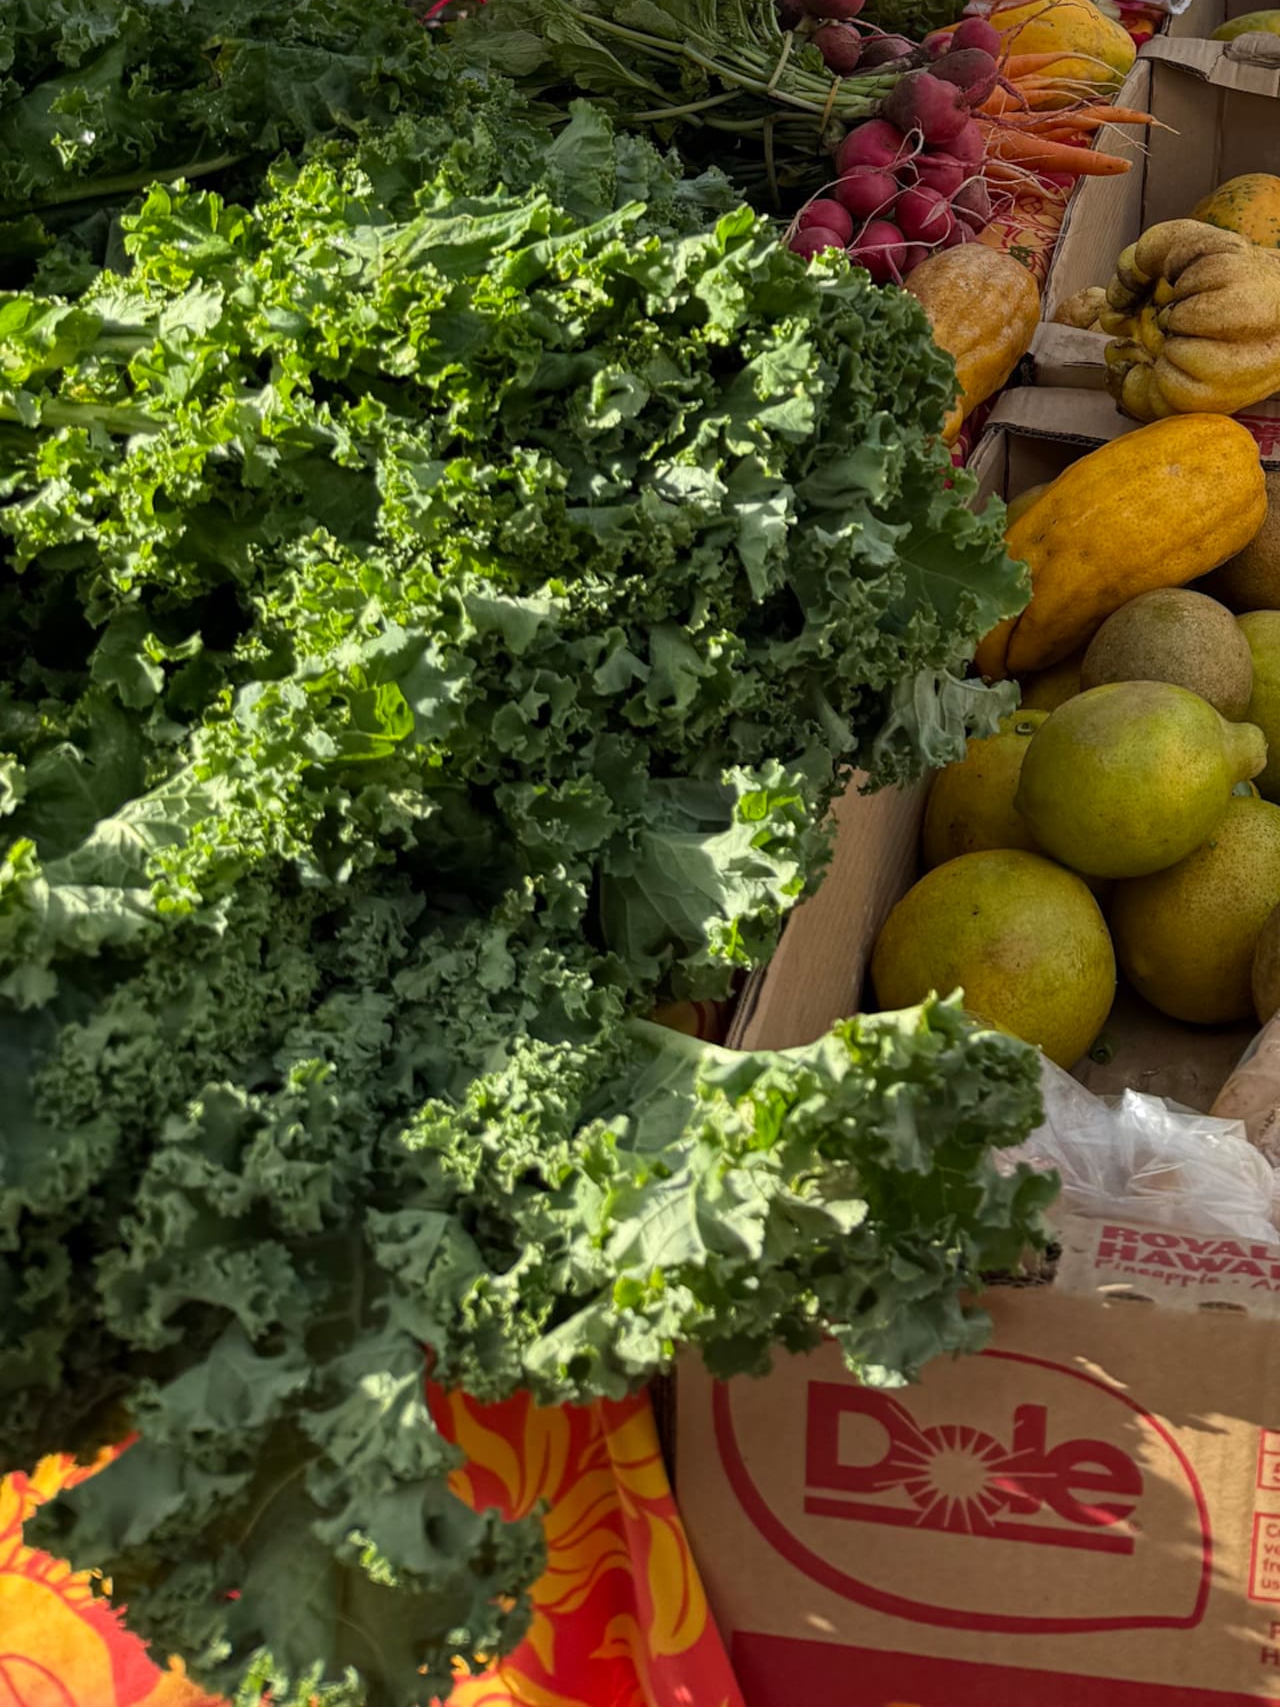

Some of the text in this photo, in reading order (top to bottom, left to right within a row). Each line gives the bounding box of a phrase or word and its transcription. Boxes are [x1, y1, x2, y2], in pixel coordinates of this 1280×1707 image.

[1101, 1225, 1280, 1262] ROYAL
[1093, 1257, 1222, 1289] Pineapple
[805, 1380, 1144, 1530] Dole
